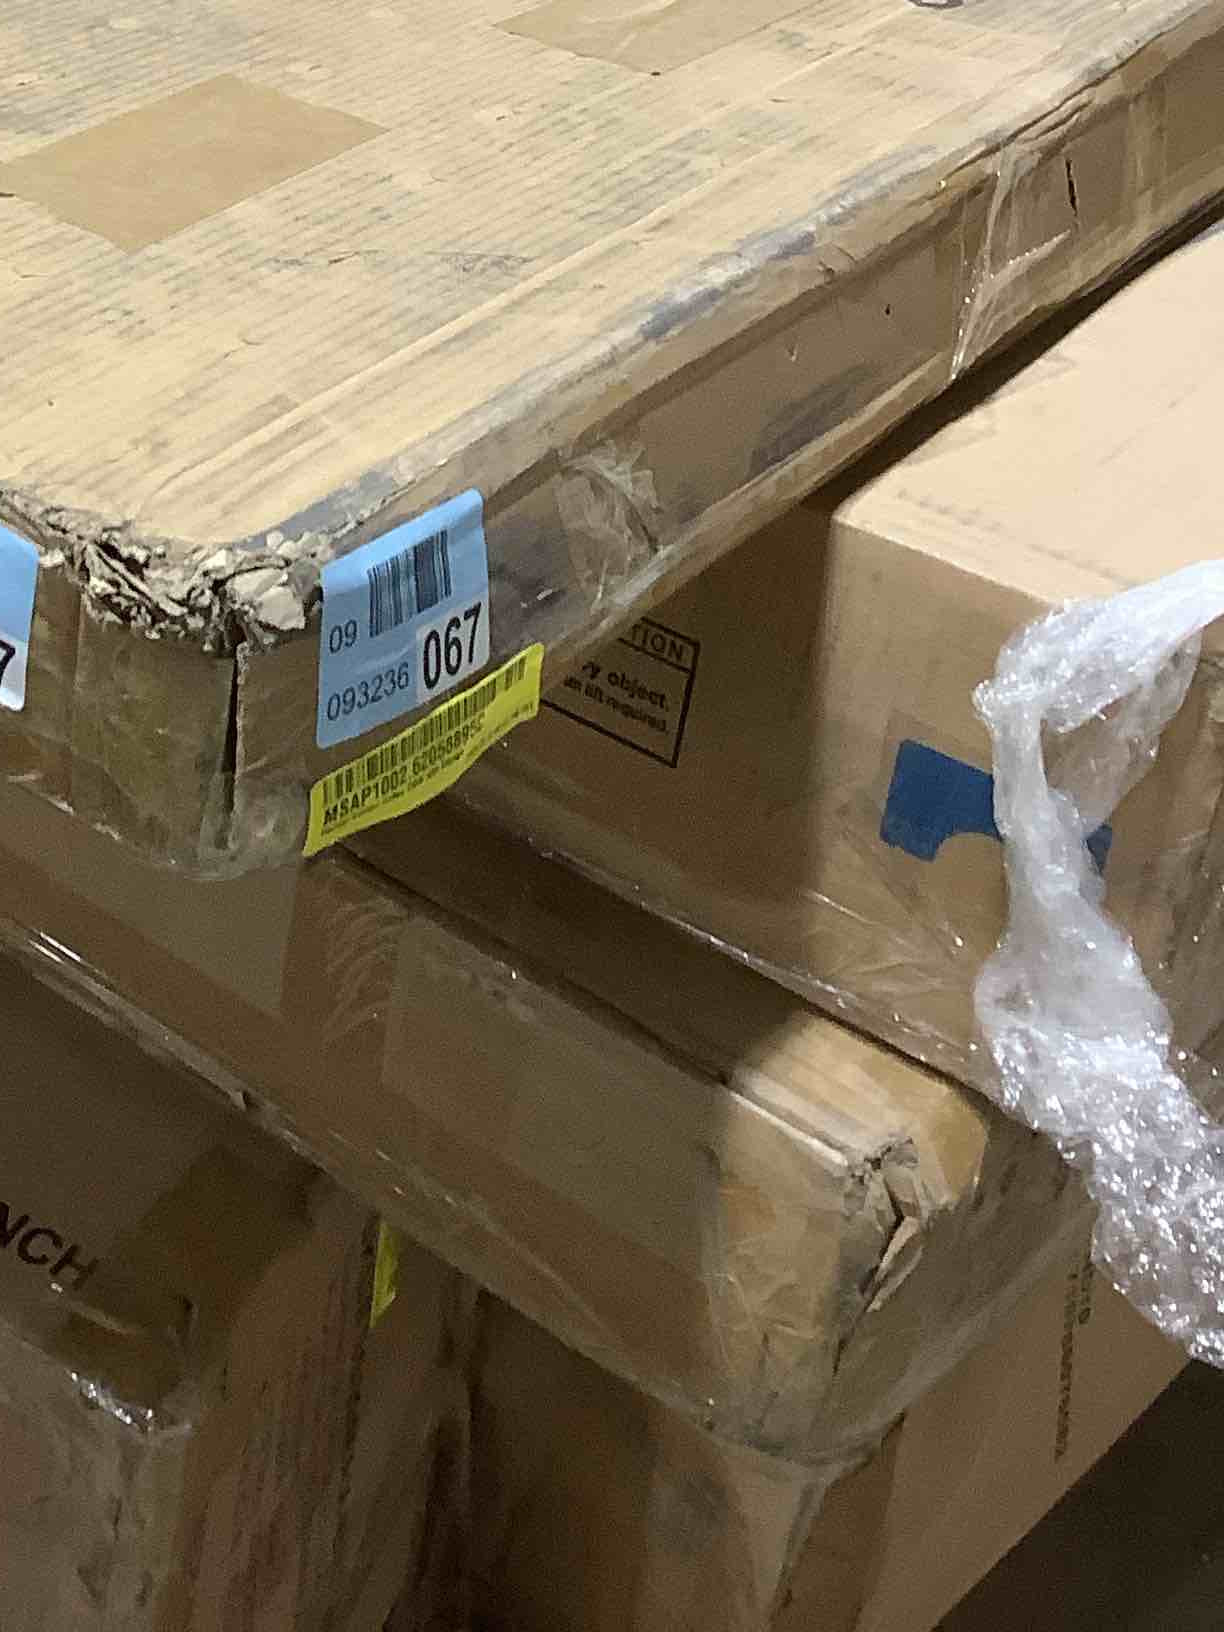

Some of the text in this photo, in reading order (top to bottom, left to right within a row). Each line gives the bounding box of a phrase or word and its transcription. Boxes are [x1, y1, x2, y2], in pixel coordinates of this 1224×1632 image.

[328, 619, 358, 655] 09
[326, 601, 482, 721] 093236 067
[607, 671, 669, 712] object,
